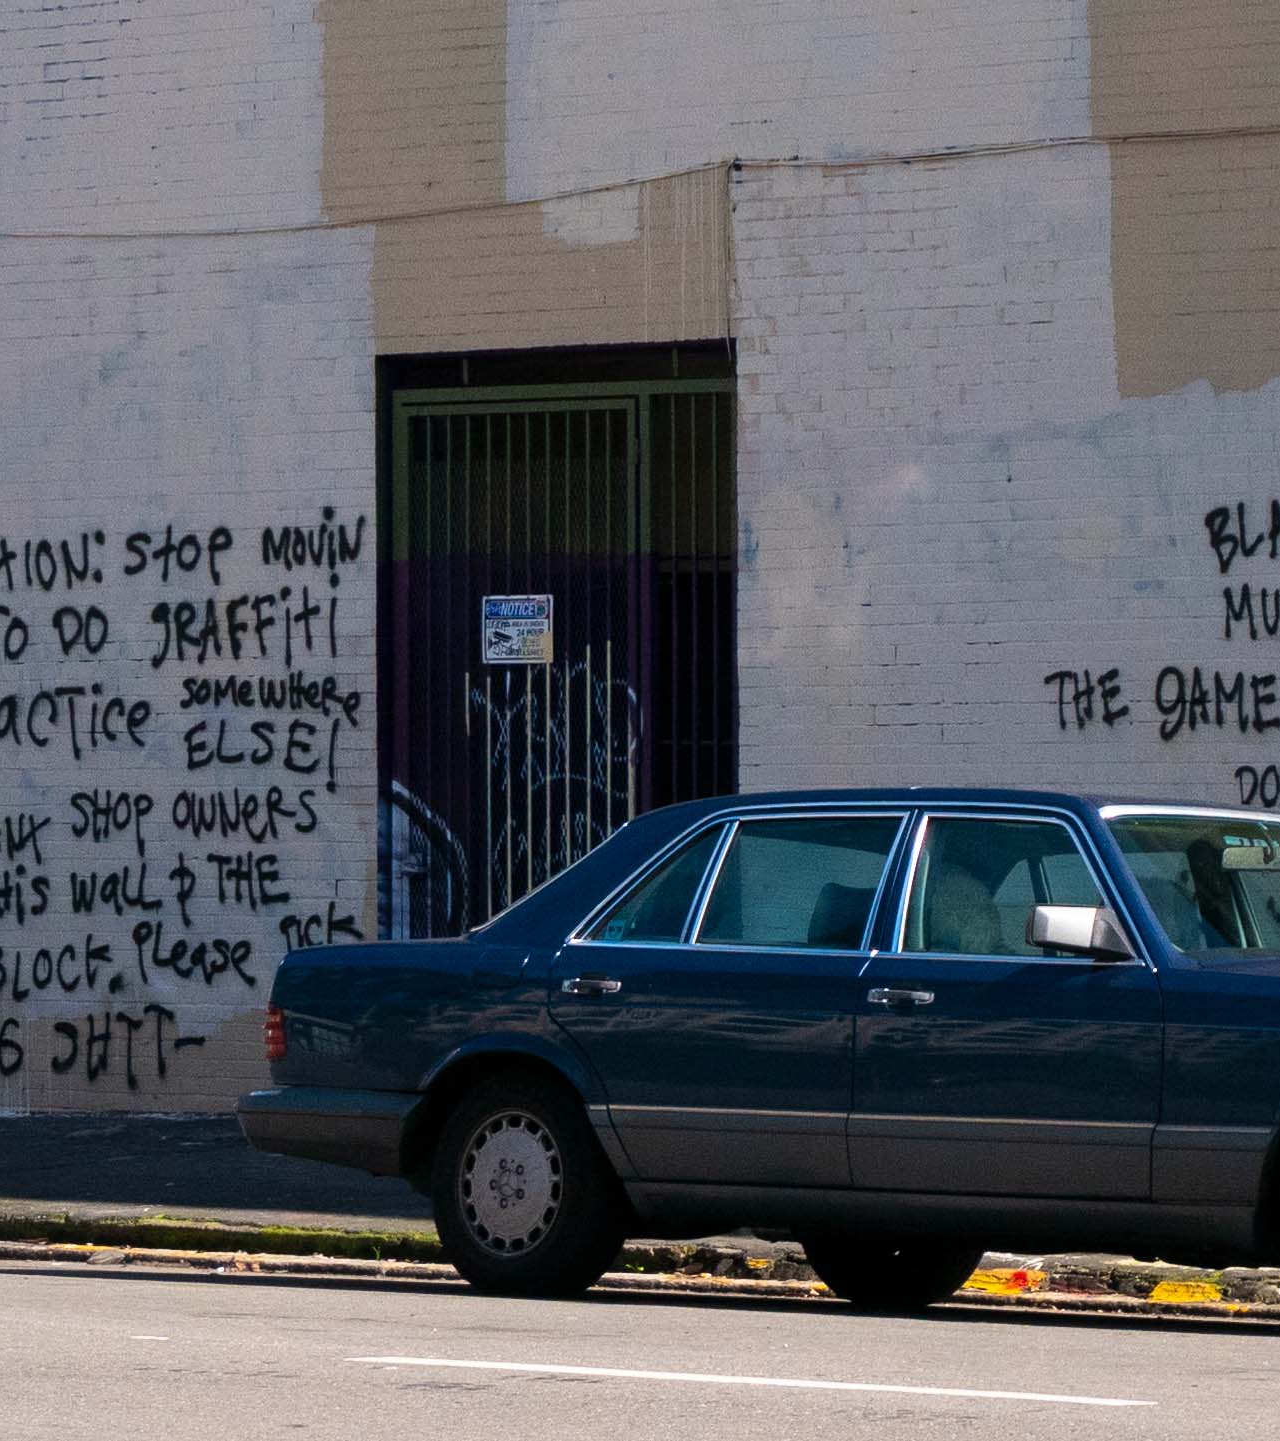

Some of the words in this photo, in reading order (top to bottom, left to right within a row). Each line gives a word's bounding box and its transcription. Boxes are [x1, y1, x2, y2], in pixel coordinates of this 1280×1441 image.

[52, 605, 109, 656] DO
[500, 602, 535, 616] NOTICE
[1044, 667, 1130, 730] THE
[184, 718, 341, 795] ELSE!
[69, 788, 156, 856] SHOP
[206, 849, 291, 911] THE
